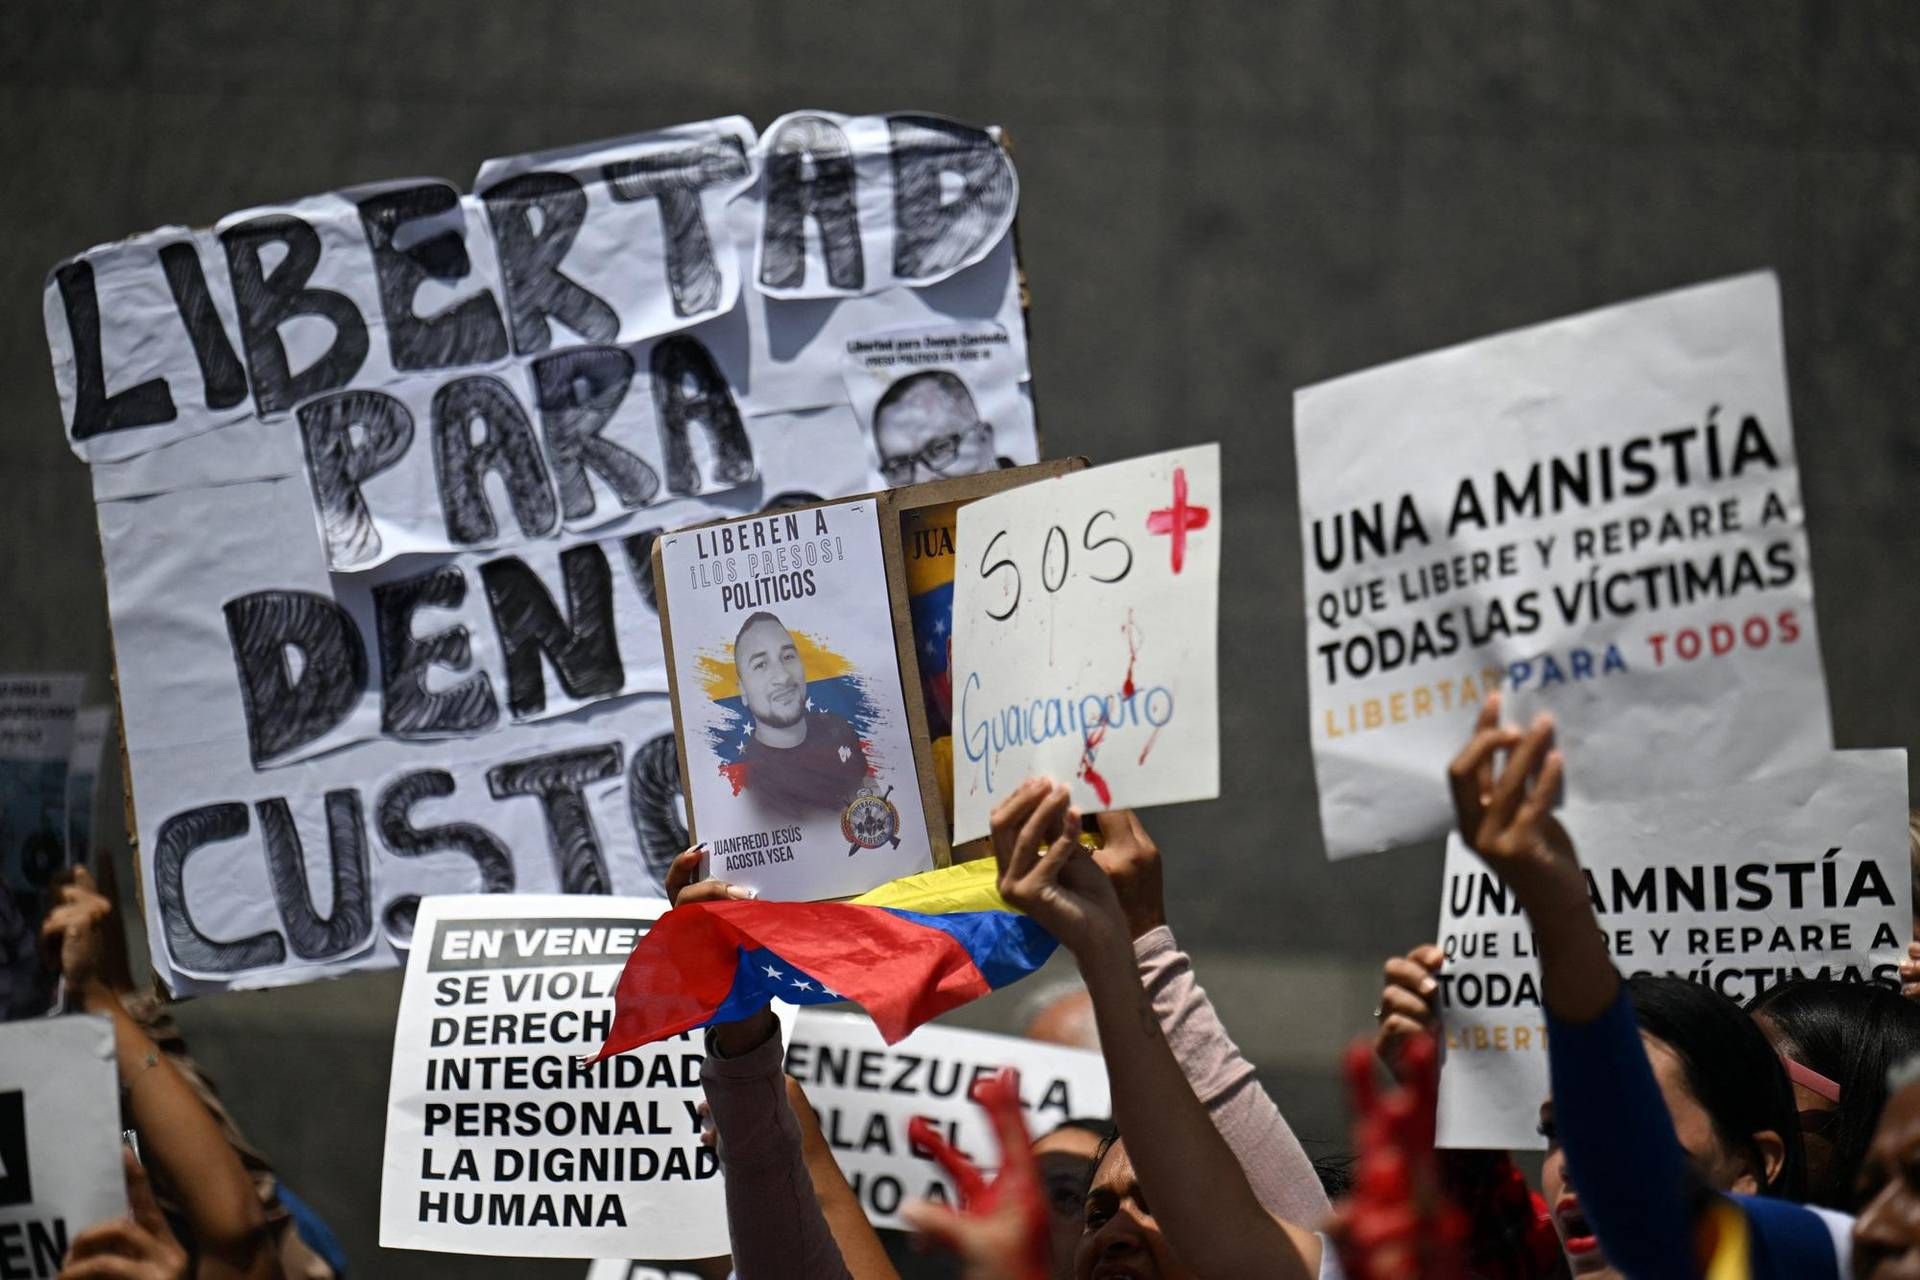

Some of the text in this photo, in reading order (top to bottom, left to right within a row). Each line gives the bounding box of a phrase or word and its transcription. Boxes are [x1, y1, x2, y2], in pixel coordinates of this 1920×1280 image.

[57, 115, 1014, 440] LIBERTAD
[297, 334, 756, 569] PARA
[1312, 405, 1779, 572] UNA AMNISTÍA
[697, 509, 829, 559] LIBEREN A
[689, 536, 843, 590] ¡LOS PRESOS!
[980, 510, 1133, 621] SOS
[1317, 492, 1789, 629] QUE LIBERE Y REPARE A
[721, 568, 817, 613] POLÍTICOS
[1317, 541, 1798, 685] TODAS LAS VÍCTIMAS
[1507, 642, 1629, 694] PARA
[1647, 609, 1801, 667] TODOS
[726, 845, 795, 871] ACOSTA YSEA
[771, 825, 803, 846] JESÚS
[441, 928, 649, 961] EN VENE
[1443, 930, 1498, 963] QUE
[1648, 929, 1672, 956] Y
[1688, 923, 1853, 955] REPARE
[1870, 921, 1900, 950] A
[434, 970, 618, 1007] SE VIOL
[1440, 958, 1900, 1009] TODA ÍCTIAS
[425, 1054, 705, 1091] INTEGRIDAD
[424, 1100, 702, 1136] PERSONAL Y
[813, 1106, 893, 1155] LA
[421, 1146, 720, 1182] LA DIGNIDAD
[418, 1191, 628, 1228] HUMANA
